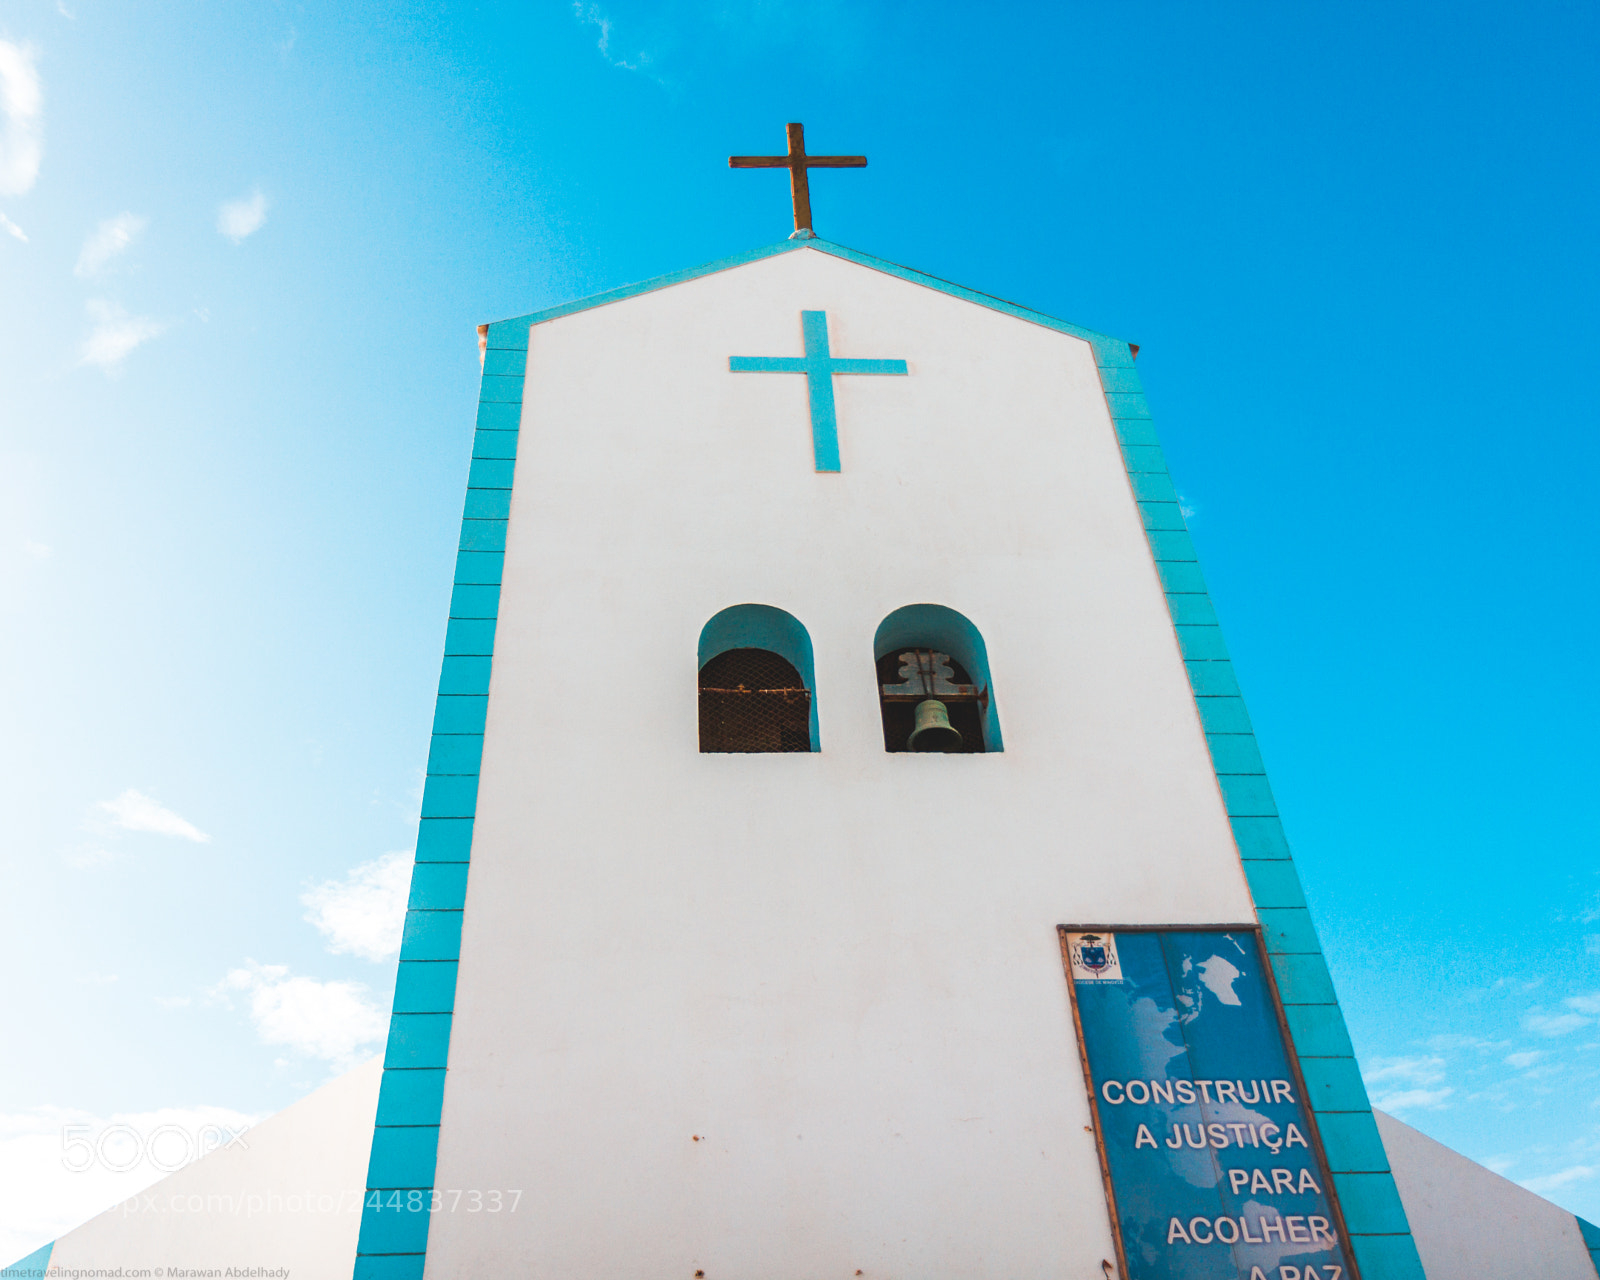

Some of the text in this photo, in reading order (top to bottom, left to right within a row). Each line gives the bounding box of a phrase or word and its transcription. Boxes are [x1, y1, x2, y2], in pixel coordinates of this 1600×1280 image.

[1101, 1079, 1296, 1106] CONSTRUIR
[1134, 1123, 1308, 1154] A JUSTIÇA
[1229, 1168, 1321, 1195] PARA
[1167, 1215, 1334, 1245] ACOLHER
